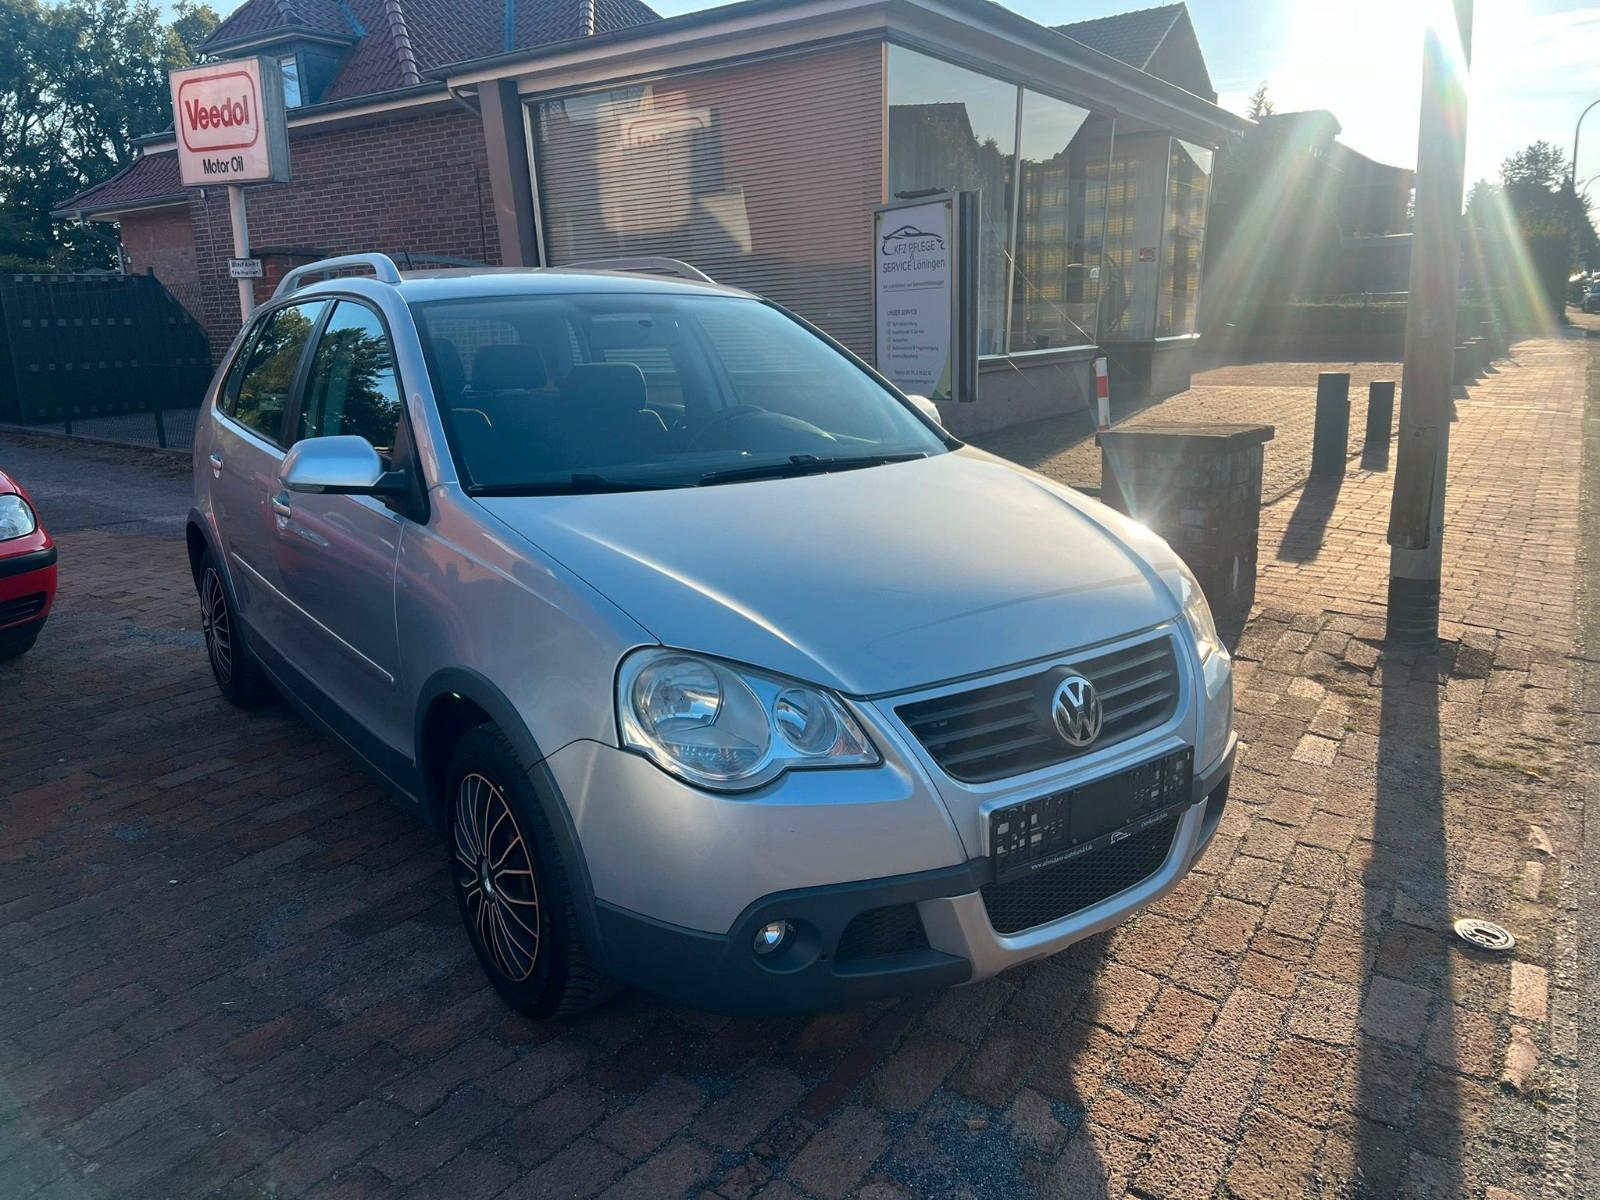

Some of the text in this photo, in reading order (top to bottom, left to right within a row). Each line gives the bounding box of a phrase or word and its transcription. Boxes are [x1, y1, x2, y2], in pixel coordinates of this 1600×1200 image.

[185, 95, 250, 131] Veedol
[203, 156, 244, 174] Motor Oil
[895, 240, 935, 254] KFZ PFLEGE
[883, 259, 945, 273] SERVICE Löningen
